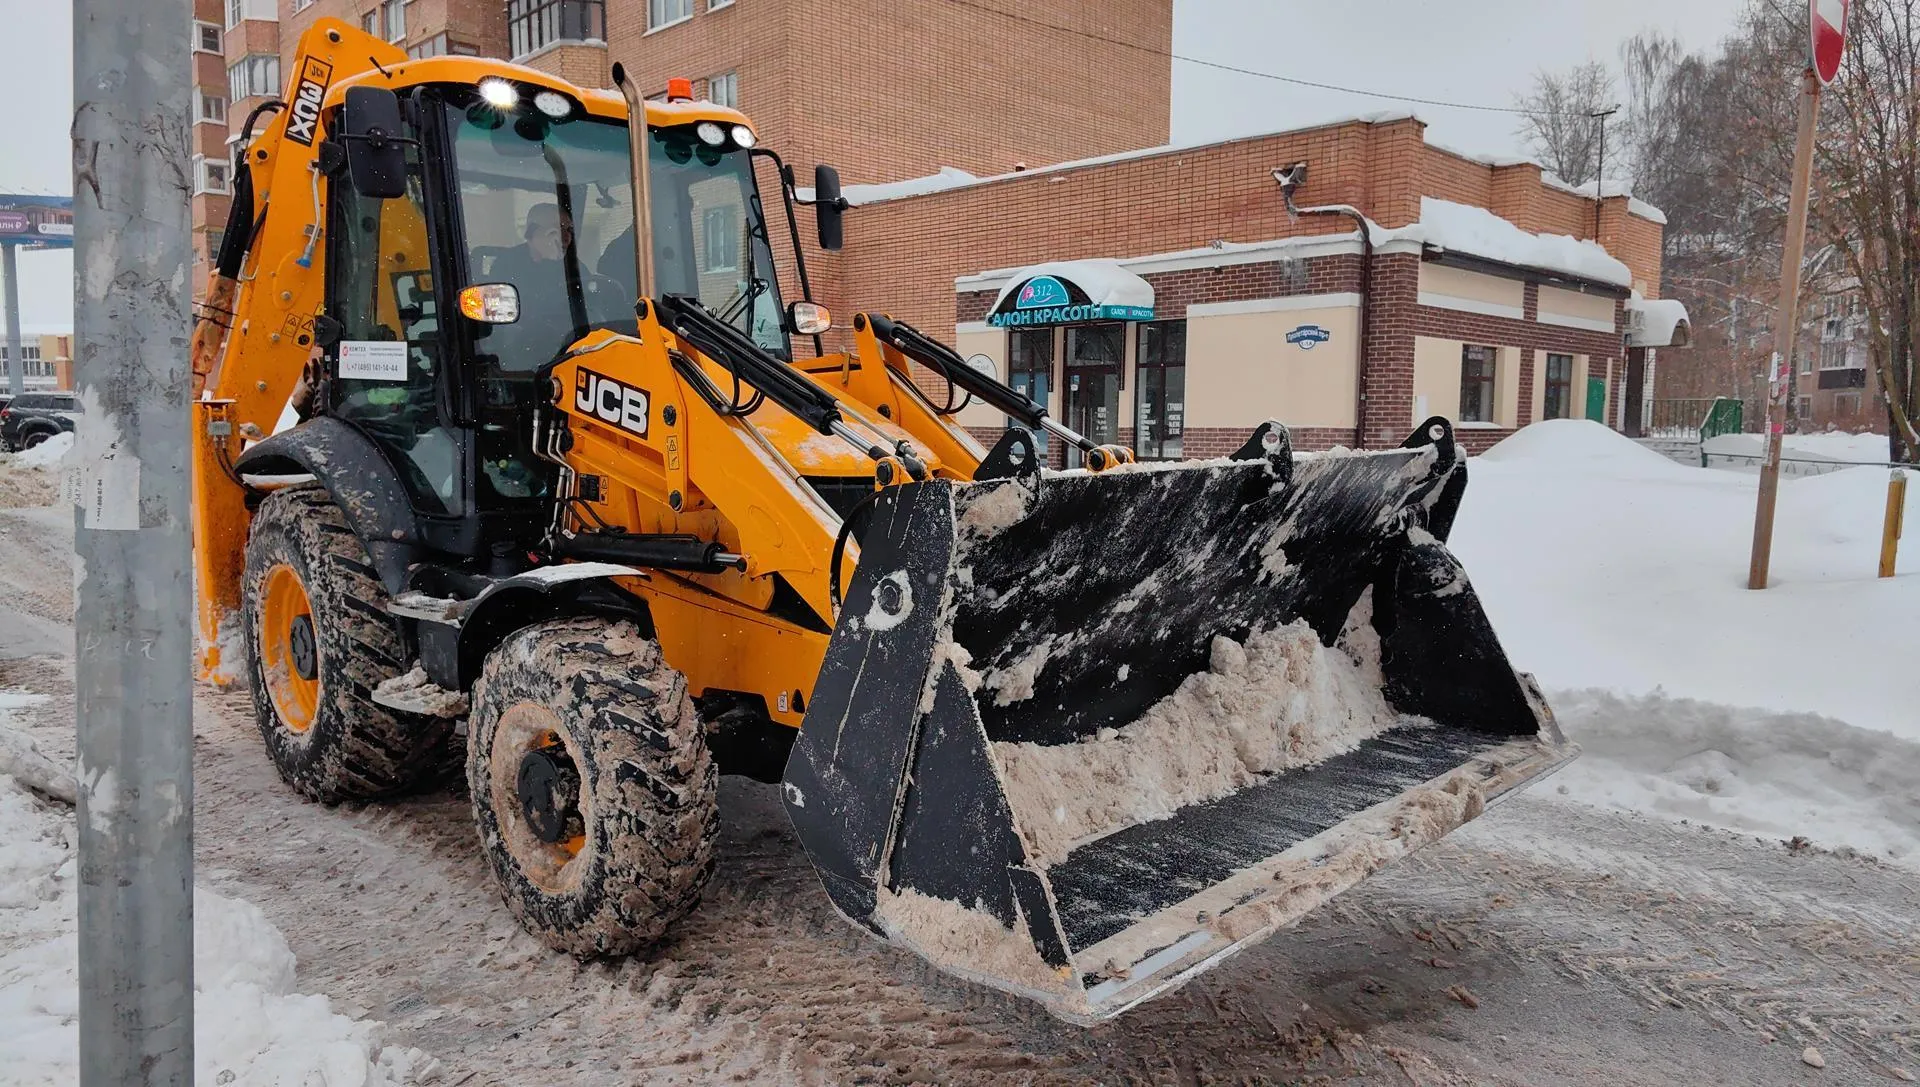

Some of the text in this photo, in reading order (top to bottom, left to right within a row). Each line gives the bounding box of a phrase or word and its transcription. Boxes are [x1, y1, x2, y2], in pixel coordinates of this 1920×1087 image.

[287, 81, 323, 140] 3CX
[1035, 284, 1052, 297] 312
[1033, 304, 1103, 323] КРАСОТЫ
[1111, 308, 1127, 317] САЛОН
[577, 374, 647, 434] JCB
